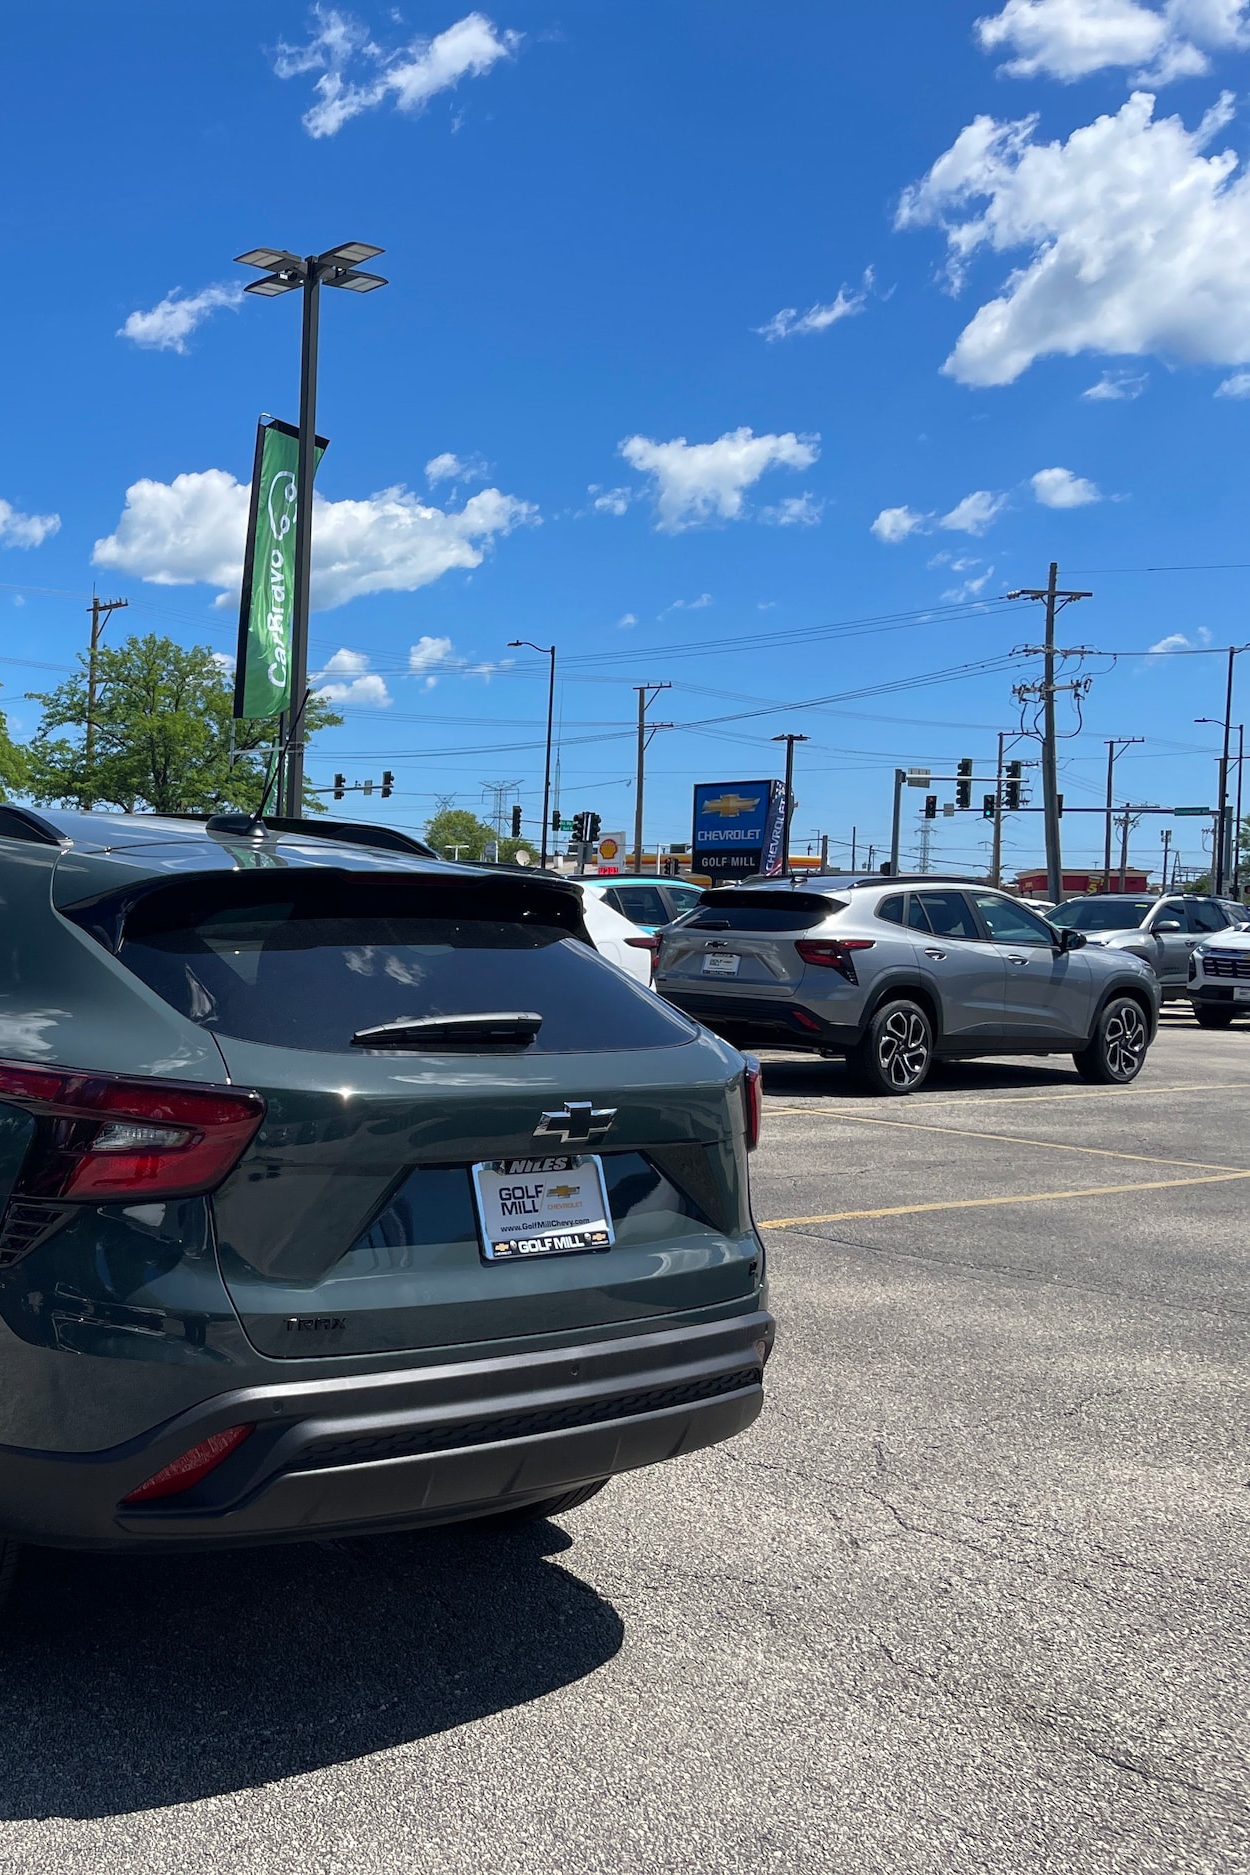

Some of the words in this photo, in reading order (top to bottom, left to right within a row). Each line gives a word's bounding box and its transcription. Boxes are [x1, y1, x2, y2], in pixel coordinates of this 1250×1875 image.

[268, 549, 287, 688] CarBravo
[697, 829, 761, 841] CHEVROLET
[765, 798, 786, 871] CHEVROLET
[701, 857, 727, 868] GOLF
[730, 857, 756, 867] MILL
[509, 1157, 567, 1174] NILES
[499, 1185, 543, 1201] GOLF
[501, 1199, 539, 1216] MILL
[547, 1202, 582, 1211] CHEVROLET
[500, 1218, 590, 1232] www.GolfMillChevy.com
[518, 1237, 553, 1254] GOLF
[553, 1234, 586, 1250] MILL
